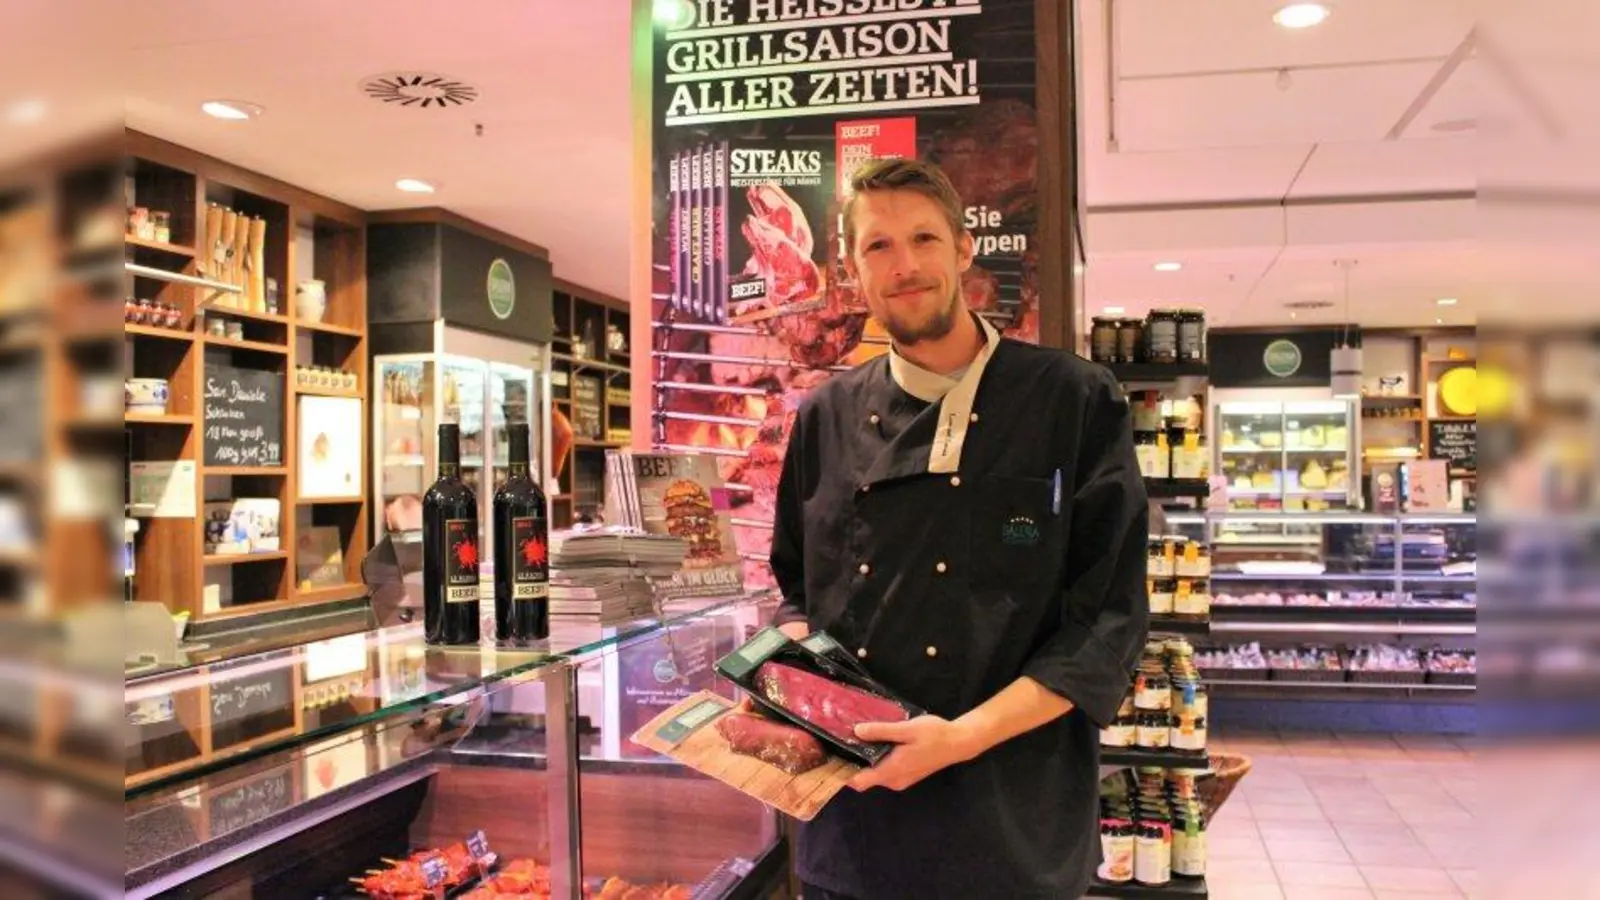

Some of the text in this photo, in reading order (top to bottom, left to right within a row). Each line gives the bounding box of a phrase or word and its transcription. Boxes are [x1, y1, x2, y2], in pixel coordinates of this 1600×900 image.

[668, 0, 734, 29] DIE
[667, 19, 951, 73] GRILLSAISON
[665, 59, 979, 116] ALLER ZEITEN!
[841, 125, 880, 139] BEEF!
[730, 149, 821, 174] STEAKS
[964, 206, 1002, 228] Sie
[971, 234, 1027, 256] ypen
[732, 282, 765, 298] BEEF!
